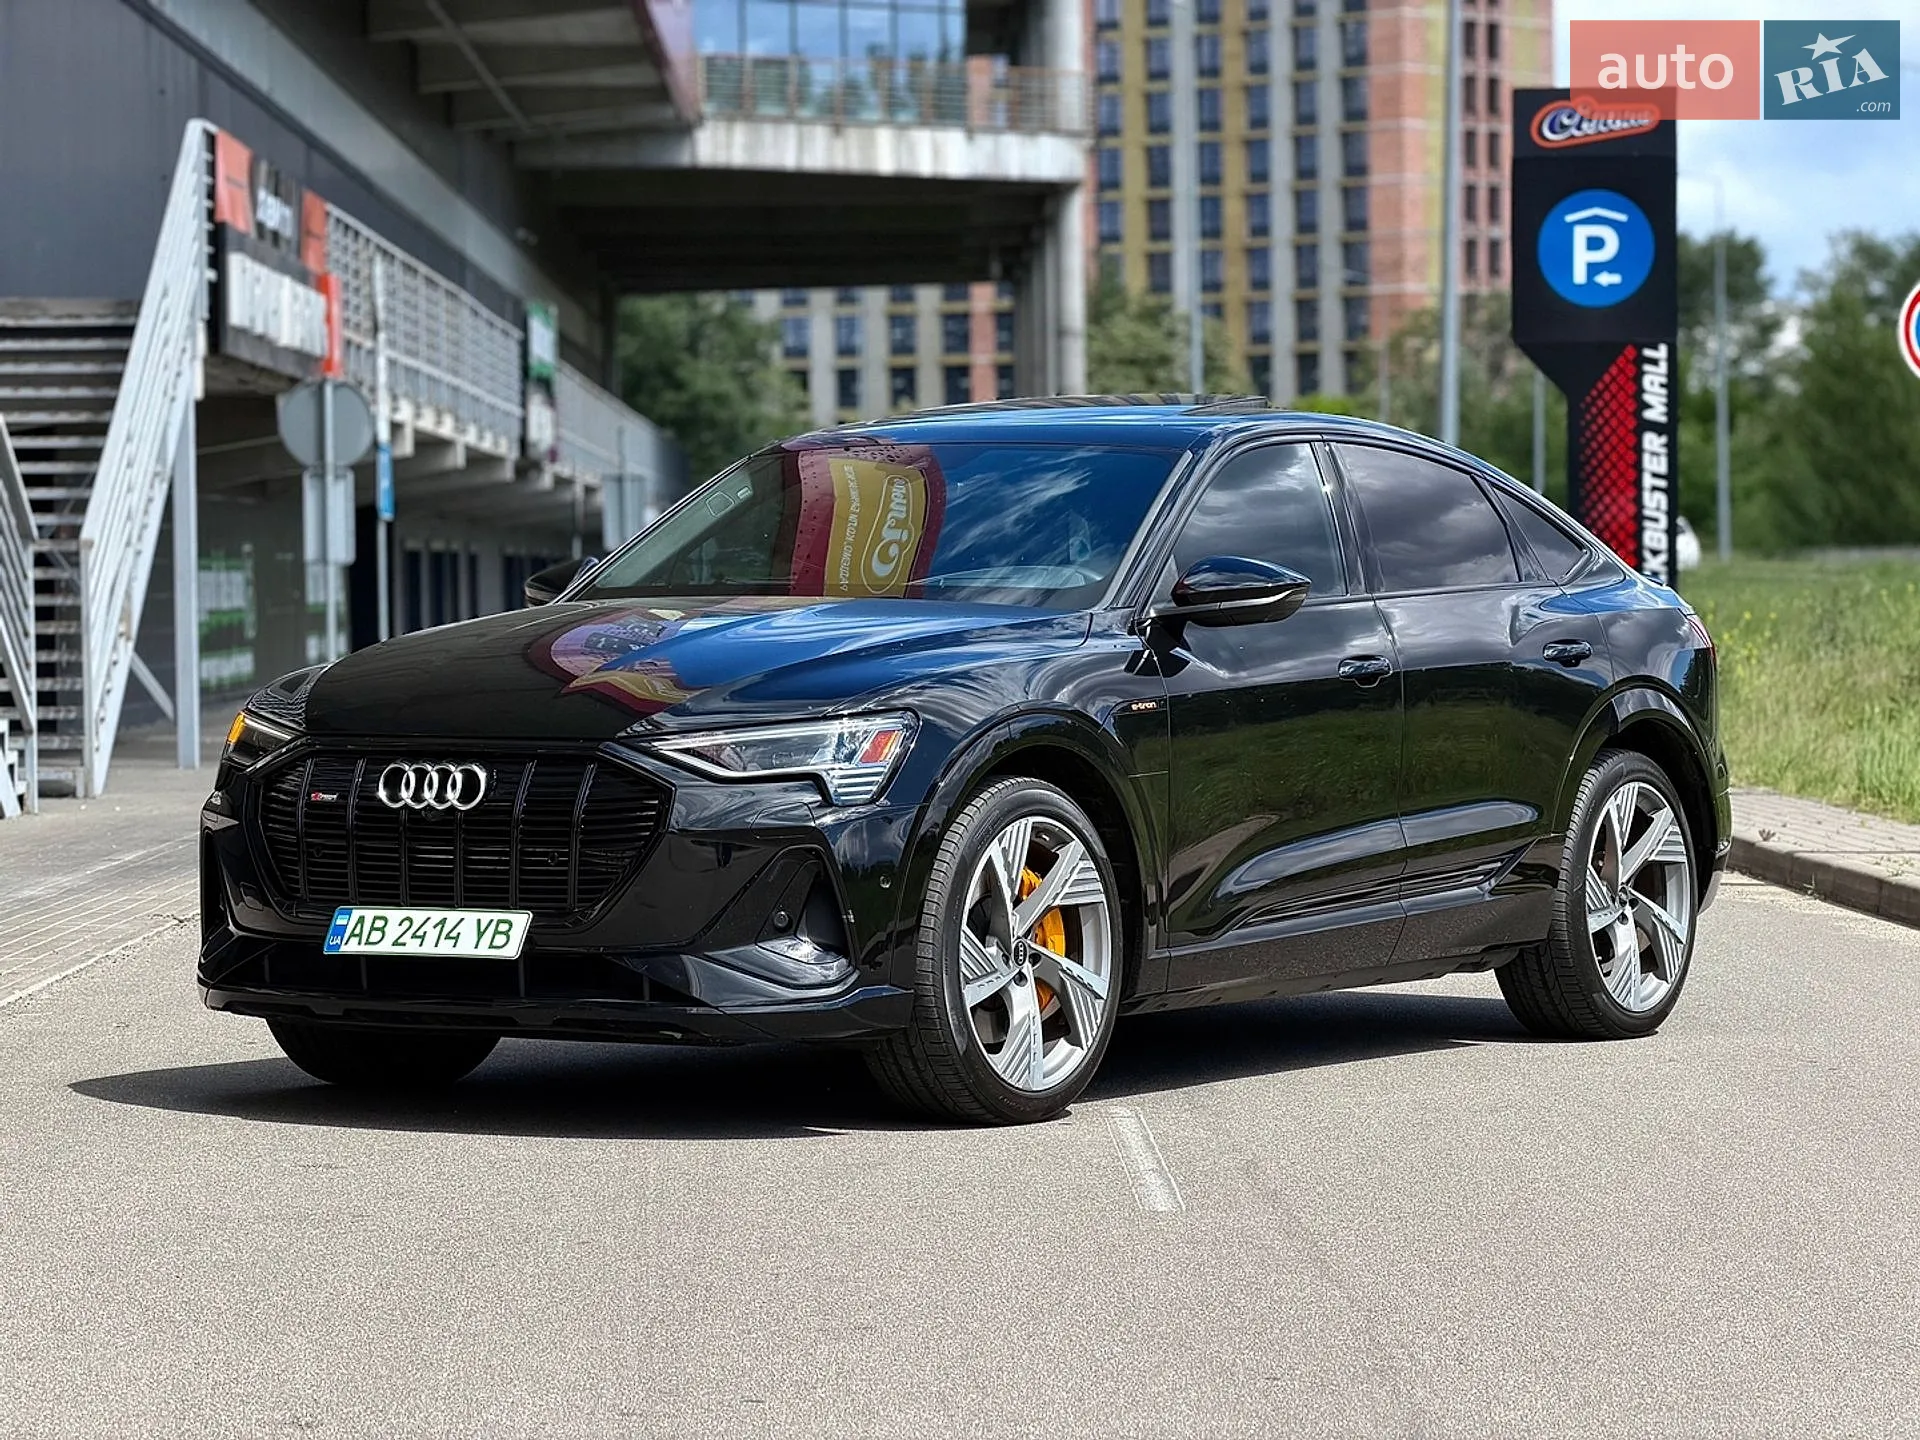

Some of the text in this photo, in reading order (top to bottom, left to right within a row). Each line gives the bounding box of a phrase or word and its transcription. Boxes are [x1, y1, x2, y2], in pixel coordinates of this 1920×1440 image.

[1572, 224, 1621, 286] P
[1642, 342, 1668, 424] MALL
[329, 936, 342, 946] UA
[344, 915, 514, 950] AB 2414 YB
